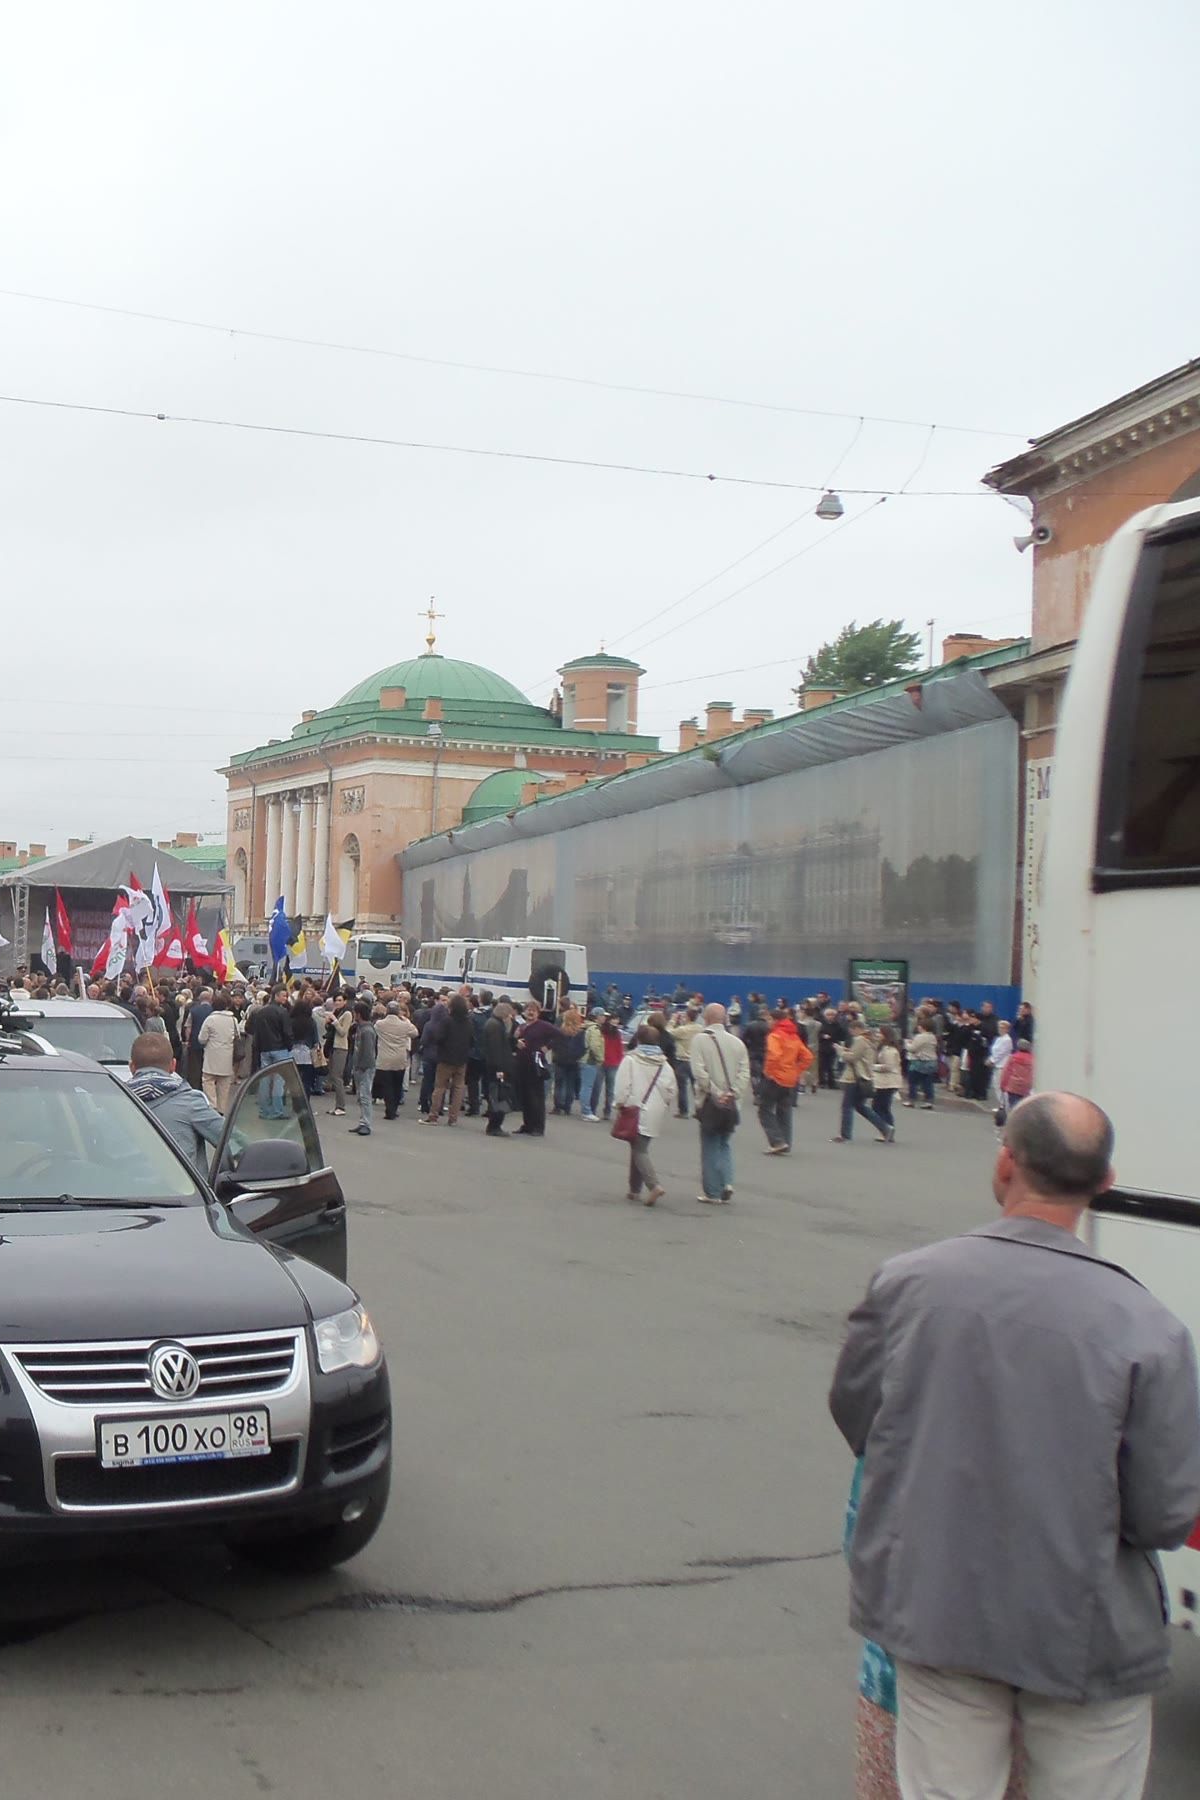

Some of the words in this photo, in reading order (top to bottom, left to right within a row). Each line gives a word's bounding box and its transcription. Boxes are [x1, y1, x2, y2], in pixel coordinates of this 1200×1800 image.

[137, 1423, 188, 1455] 100
[233, 1415, 258, 1438] 98
[232, 1438, 251, 1448] RUS
